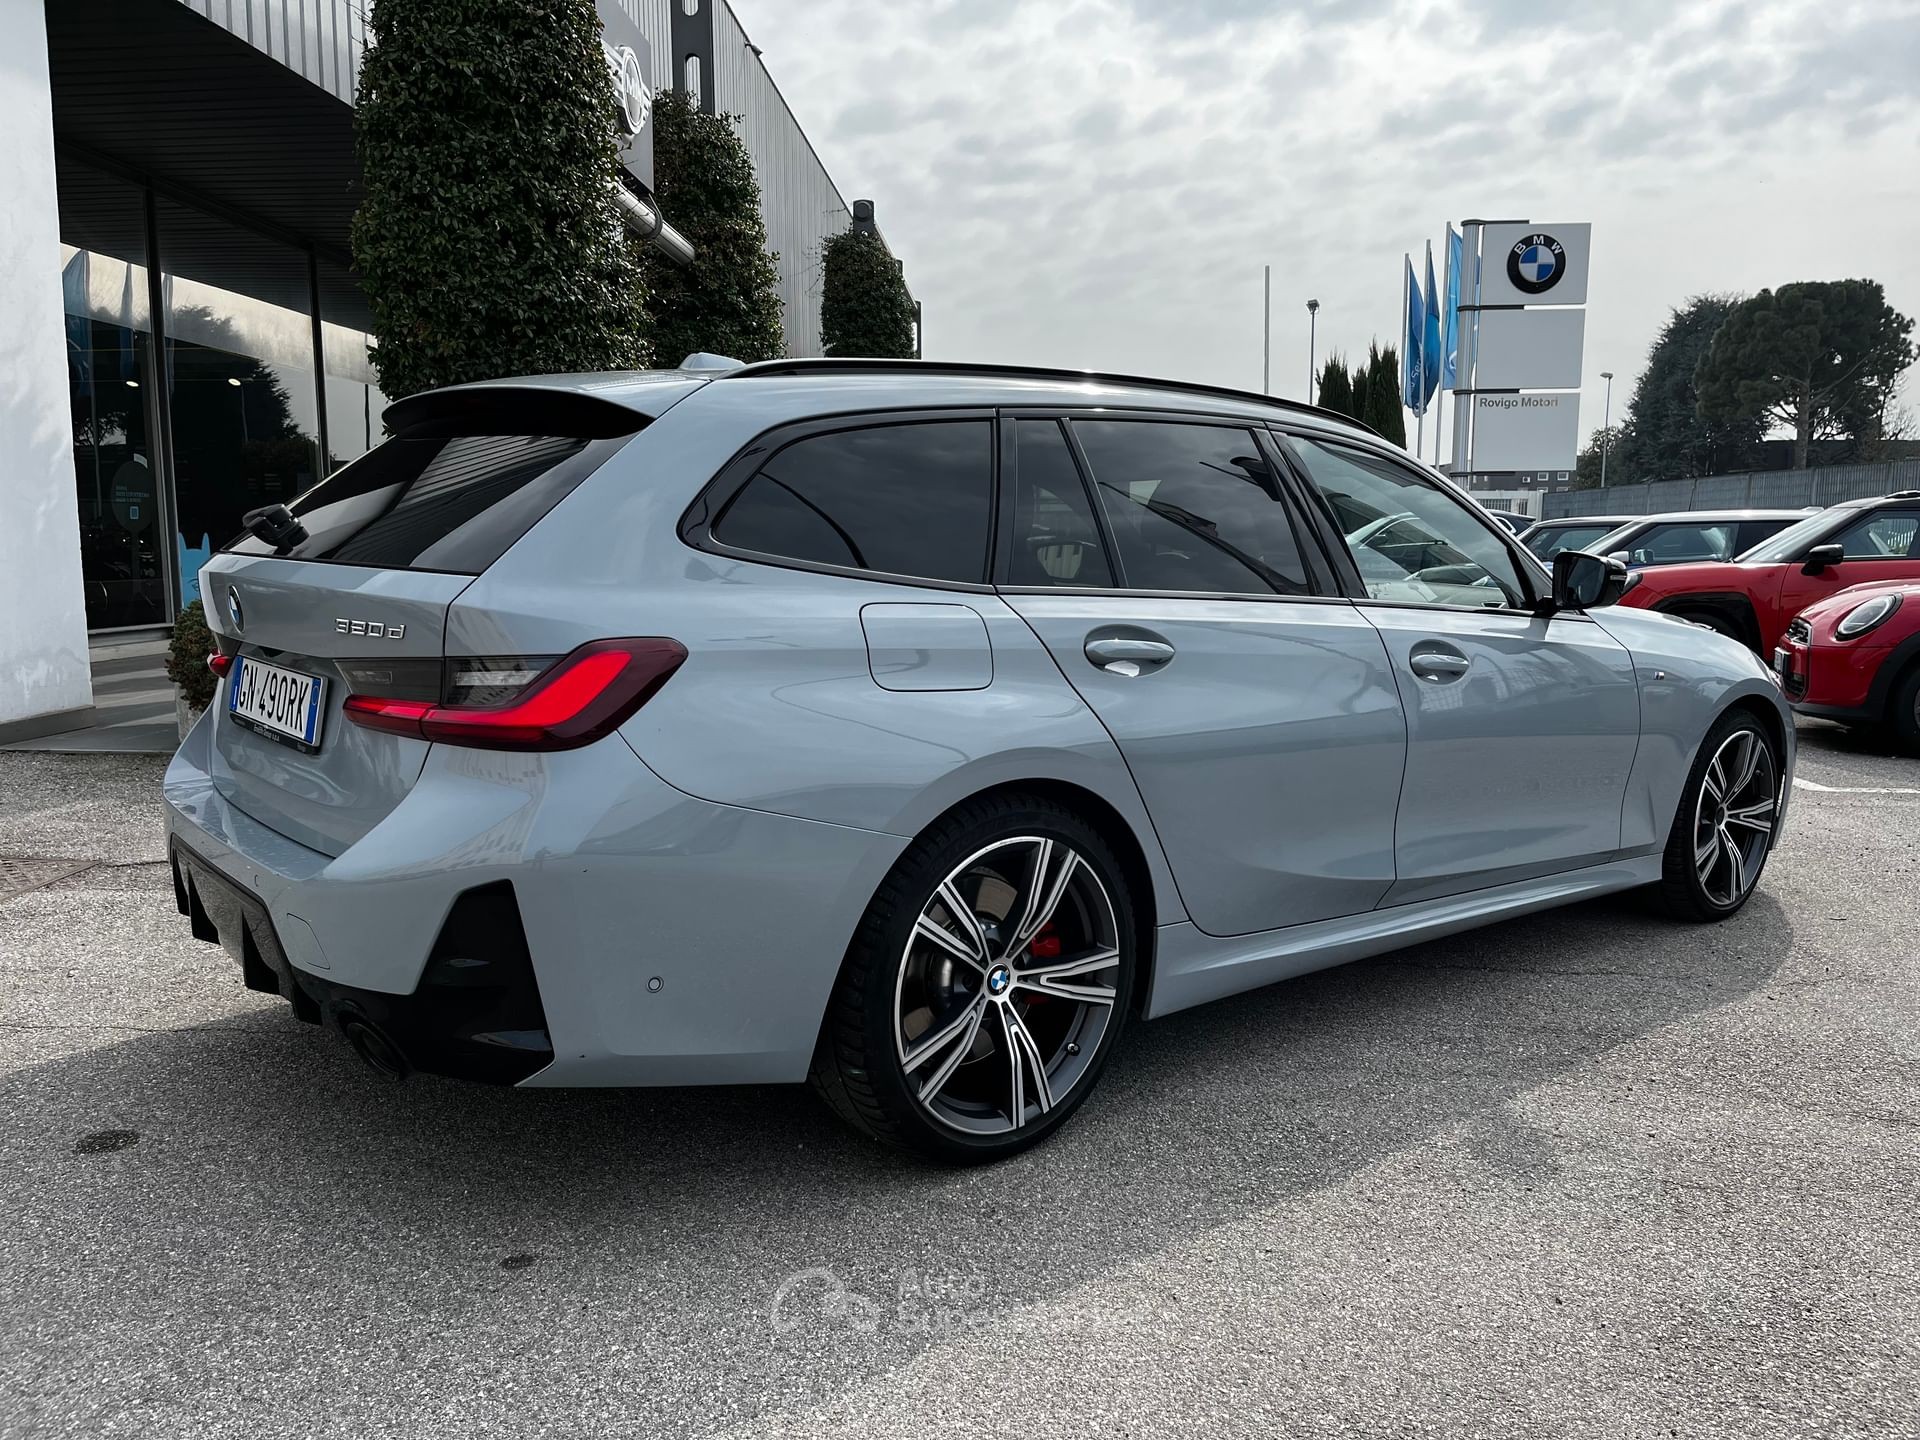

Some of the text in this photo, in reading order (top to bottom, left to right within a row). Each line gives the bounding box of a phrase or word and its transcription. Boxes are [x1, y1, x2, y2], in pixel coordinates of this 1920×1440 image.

[1513, 235, 1563, 255] BMW
[1479, 396, 1559, 410] Rovigo Motori
[238, 663, 309, 733] GN 490RK
